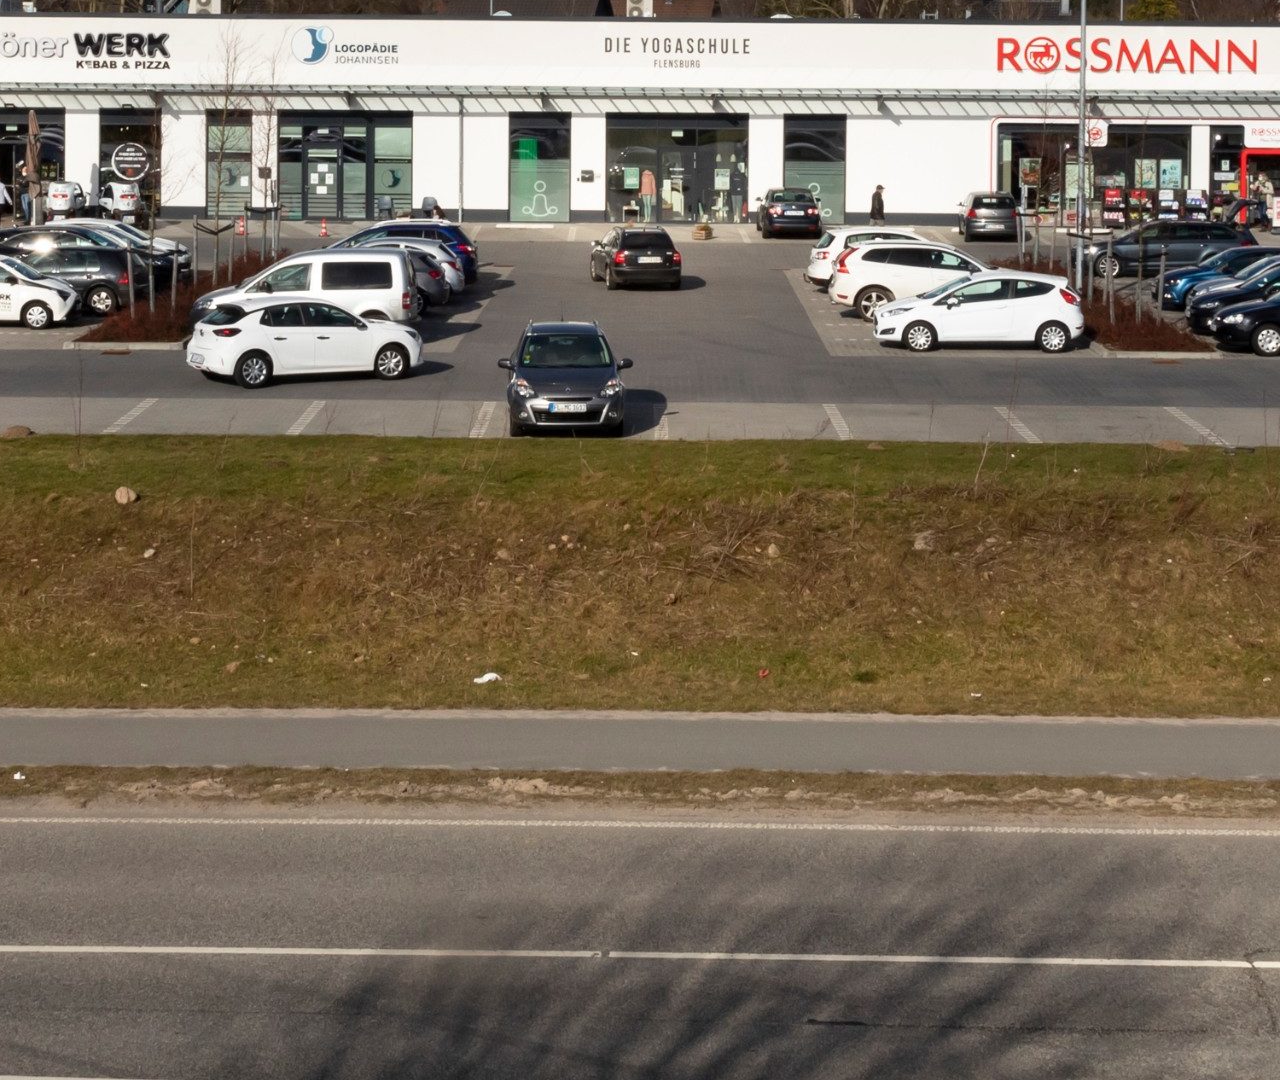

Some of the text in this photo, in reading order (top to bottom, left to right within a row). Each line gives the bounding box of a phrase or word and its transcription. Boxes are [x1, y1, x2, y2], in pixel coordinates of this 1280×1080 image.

[73, 33, 171, 58] WERK
[334, 43, 399, 53] LOGOPÄDIE
[604, 37, 751, 54] DIE YOGASCHULE
[334, 55, 399, 64] JOHANNSEN
[996, 36, 1258, 75] ROSSMANN
[76, 60, 171, 70] KEBAB & PIZZA
[653, 59, 701, 69] FLENSBURG
